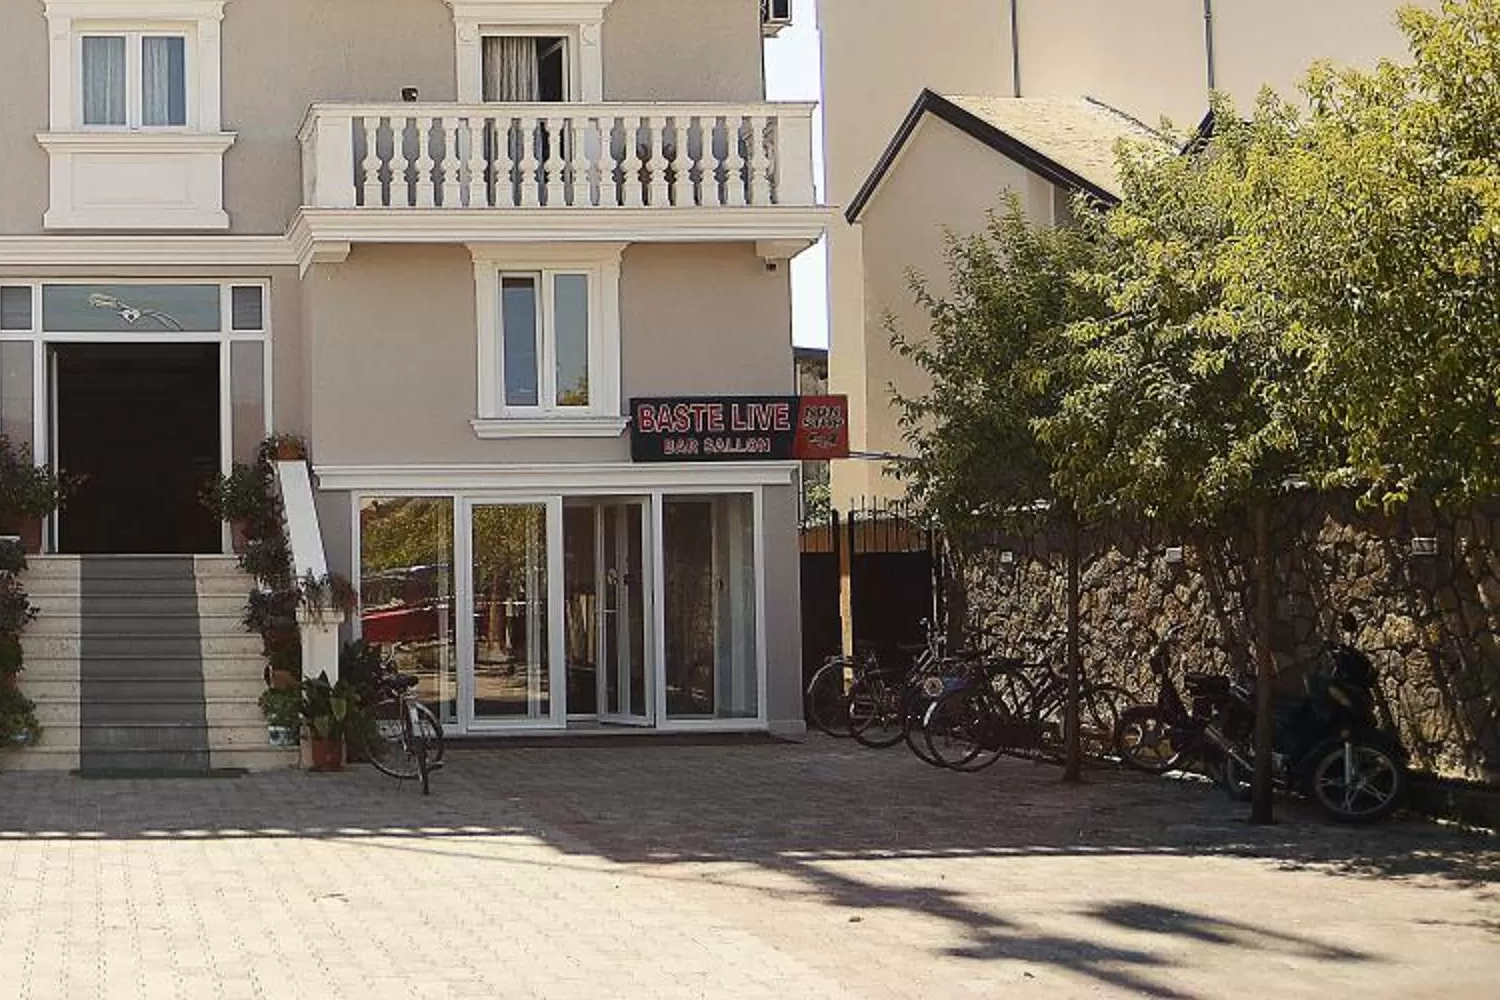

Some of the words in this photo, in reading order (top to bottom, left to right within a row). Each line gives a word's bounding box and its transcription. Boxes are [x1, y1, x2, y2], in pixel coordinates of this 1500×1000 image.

[638, 403, 725, 432] BASTE
[731, 403, 791, 431] LIVE
[663, 438, 699, 455] BAR
